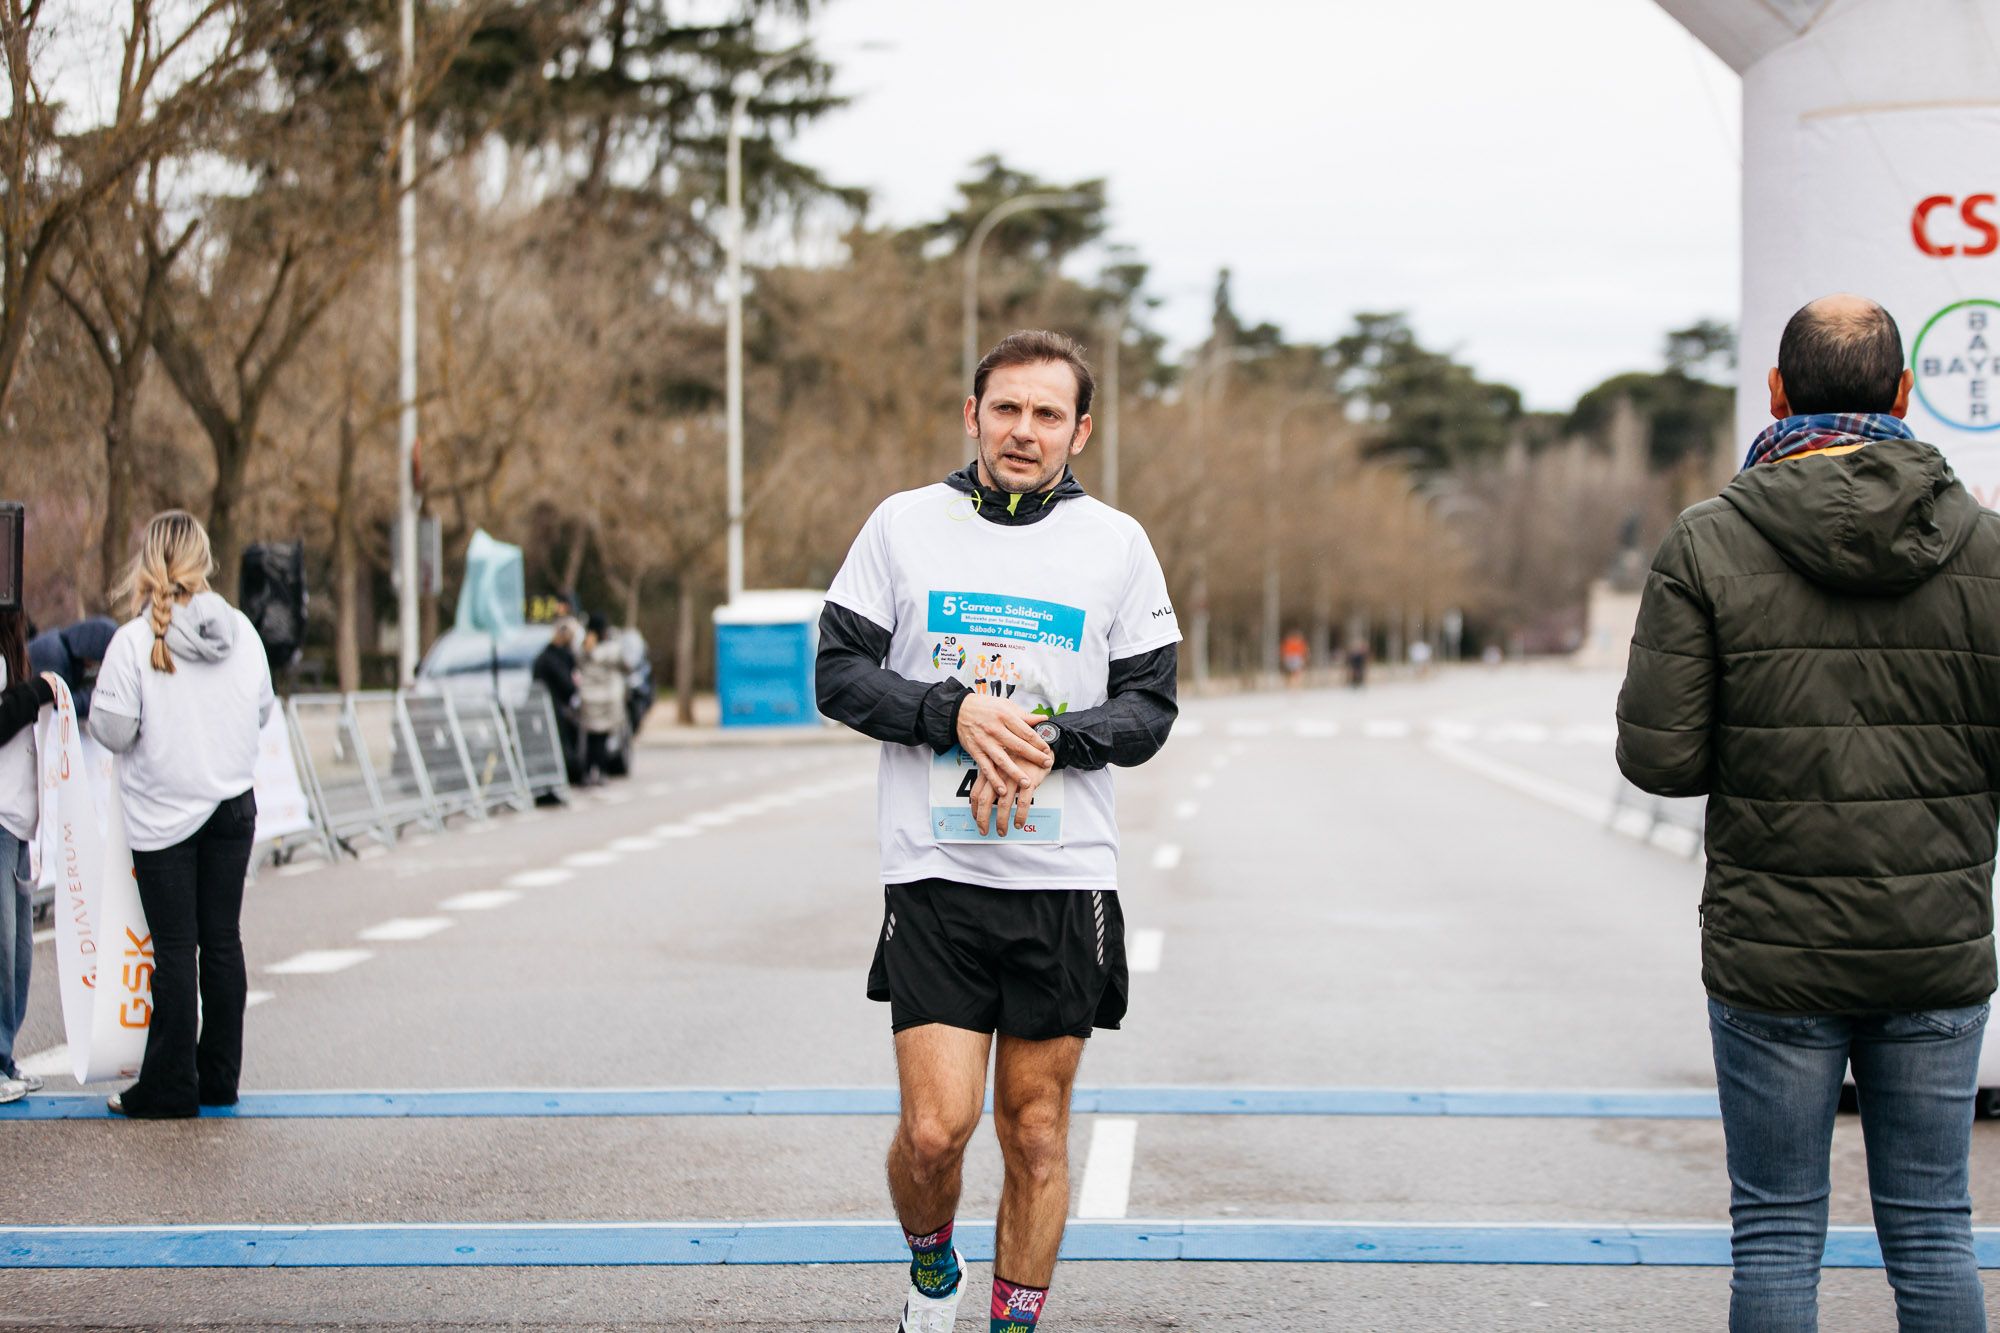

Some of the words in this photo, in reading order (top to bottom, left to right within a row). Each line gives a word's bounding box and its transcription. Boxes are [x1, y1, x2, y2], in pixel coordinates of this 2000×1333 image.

[1910, 194, 2000, 257] CS
[960, 601, 1001, 614] Carrera
[1005, 604, 1054, 621] Solidaria
[944, 636, 956, 645] 20
[969, 625, 996, 634] Sábado
[1003, 628, 1012, 636] de
[1014, 631, 1038, 640] marzo
[1038, 631, 1074, 651] 2026
[982, 641, 1007, 649] MONCLOA
[1023, 825, 1037, 833] CSL
[63, 822, 97, 956] DIAVERUM
[119, 925, 156, 1029] GSK
[1011, 1288, 1043, 1302] KEEP
[1007, 1297, 1040, 1313] CALM
[1009, 1307, 1034, 1321] RUN
